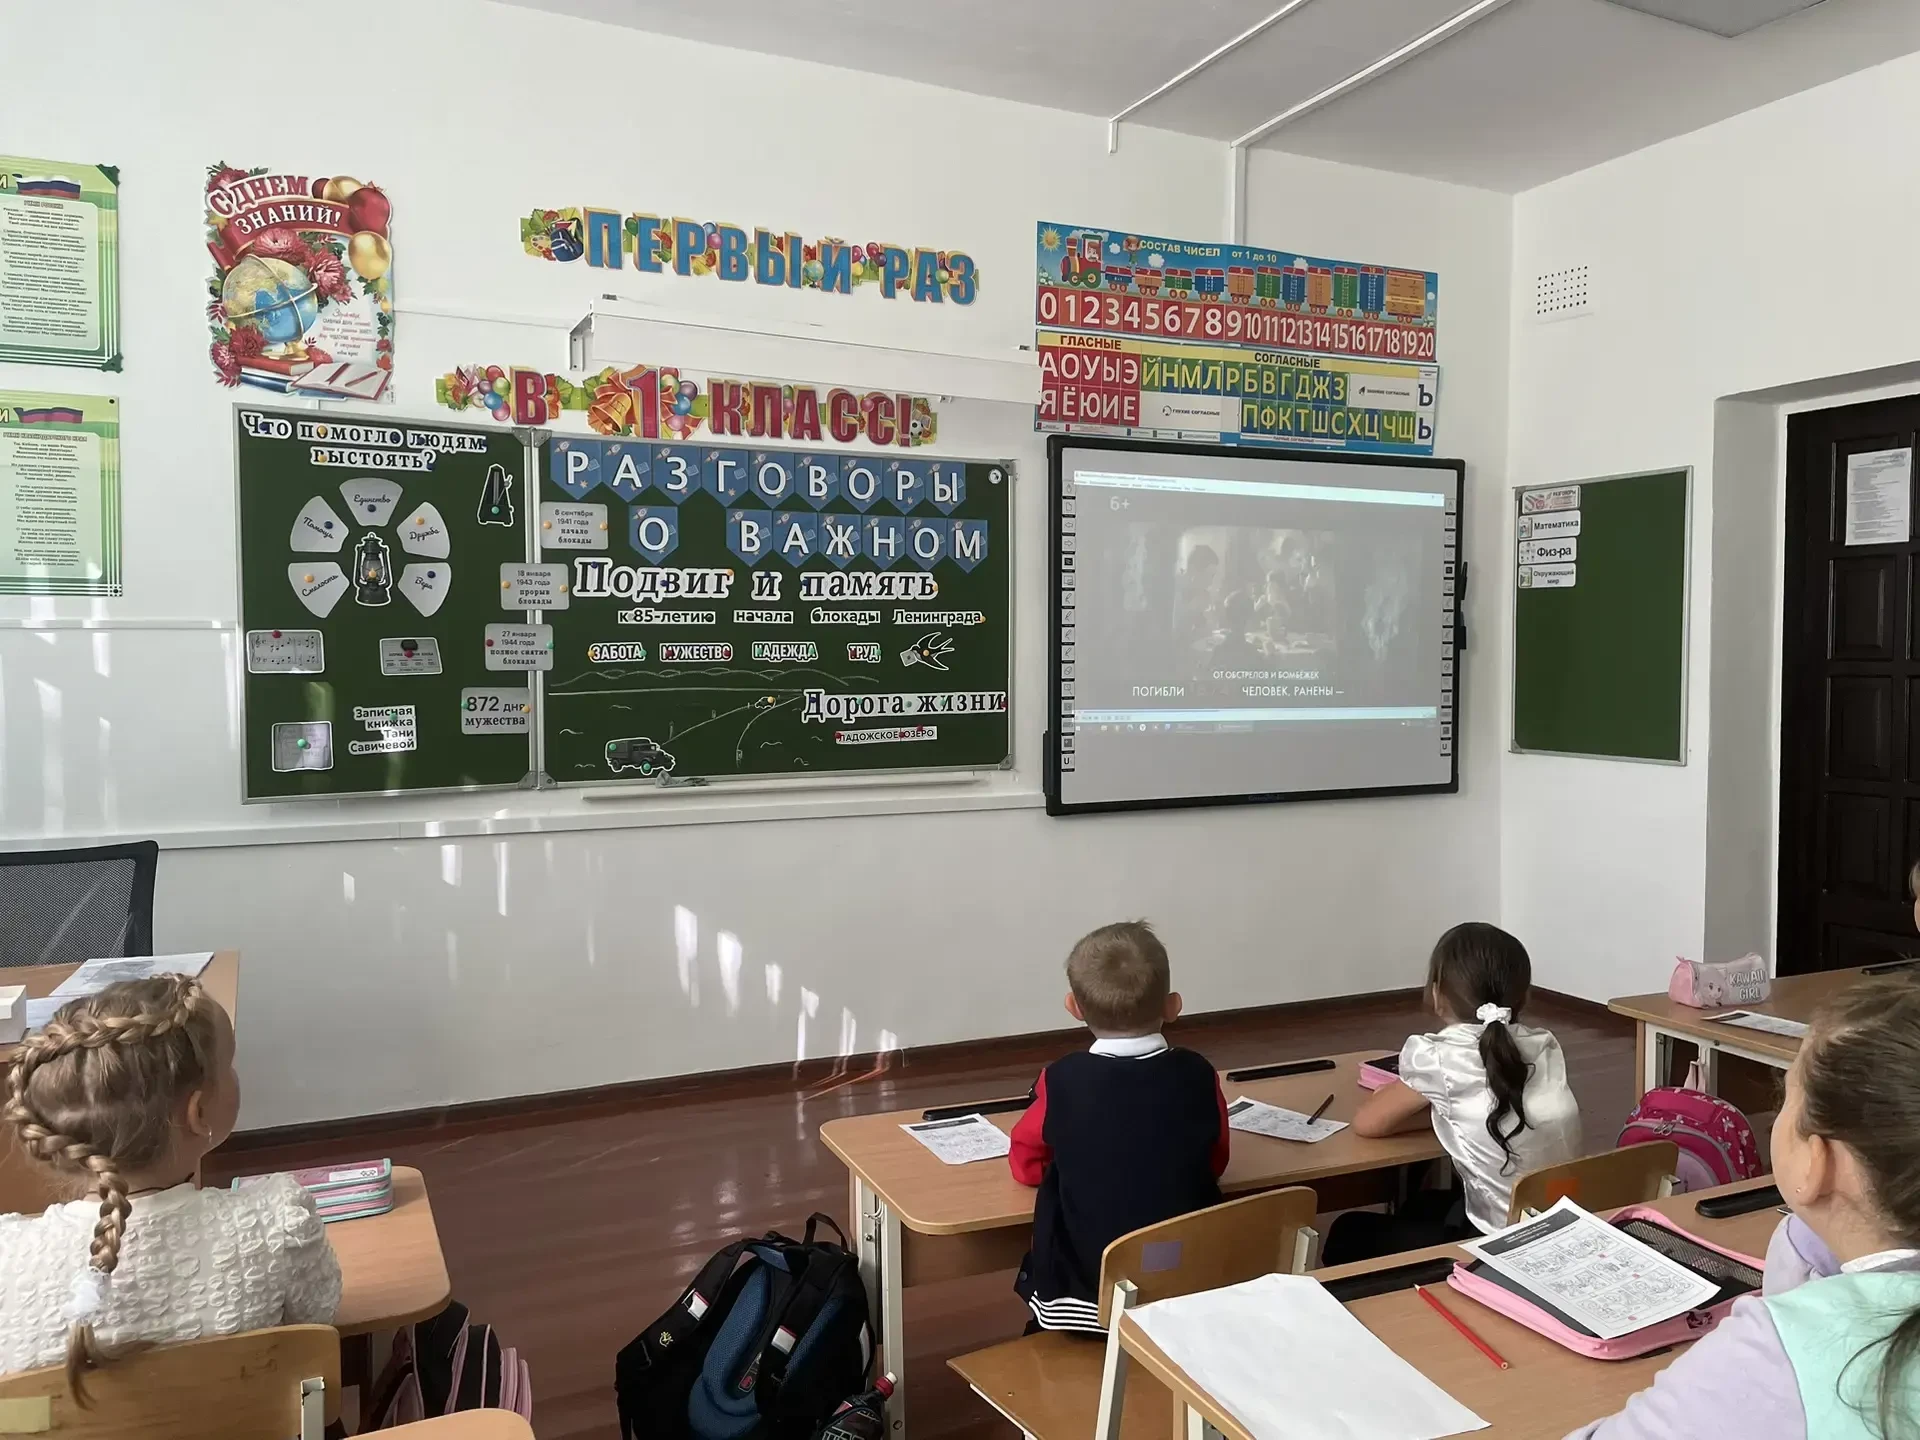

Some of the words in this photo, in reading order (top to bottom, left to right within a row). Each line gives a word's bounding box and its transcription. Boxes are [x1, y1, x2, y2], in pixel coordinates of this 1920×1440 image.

[229, 175, 308, 209] ДНЕМ
[234, 204, 342, 234] ЗНАНИЙ!
[1139, 239, 1181, 254] СОСТАВ
[1184, 246, 1221, 257] ЧИСЕЛ
[583, 207, 853, 294] ПЕРВЫЙ
[880, 243, 977, 305] РАЗ
[1245, 250, 1250, 259] 1
[1252, 253, 1264, 262] до
[1266, 254, 1277, 263] 10
[1040, 292, 1057, 320] 0
[1065, 295, 1076, 322] 1
[1083, 296, 1100, 324] 2
[1105, 298, 1120, 326] 3
[1124, 301, 1140, 329] 4
[1145, 303, 1160, 330] 5
[1164, 305, 1181, 332] 6
[1184, 307, 1201, 334] 7
[1205, 308, 1222, 336] 8
[1226, 310, 1242, 337] 9
[1244, 312, 1261, 339] 10
[1263, 315, 1278, 342] 11
[1280, 317, 1296, 344] 12
[1297, 319, 1313, 346] 13
[1314, 321, 1330, 347] 14
[1332, 323, 1349, 349] 15
[1350, 325, 1366, 351] 16
[1367, 326, 1384, 352] 17
[1384, 328, 1400, 354] 18
[1401, 330, 1417, 355] 19
[1418, 332, 1434, 357] 20
[1060, 335, 1122, 350] ГЛАСНЫЕ
[1254, 352, 1321, 369] СОГЛАСНЫЕ
[509, 366, 547, 425] В
[627, 367, 660, 439] 1
[707, 377, 912, 447] КЛАСС!
[244, 414, 289, 436] Что
[300, 424, 401, 444] помогло
[410, 433, 486, 451] людям
[566, 451, 958, 502] РАЗГОВОРЫ
[353, 494, 391, 506] Единство
[1110, 496, 1130, 511] 6+
[304, 517, 334, 539] Помощь
[1534, 519, 1579, 530] Математика
[409, 527, 439, 542] Дружба
[638, 517, 669, 552] О
[740, 520, 981, 560] ВАЖНОМ
[1537, 547, 1572, 558] Физ-ра
[577, 562, 732, 598] Подвиг
[754, 574, 777, 596] и
[803, 575, 935, 597] память
[1533, 569, 1575, 578] Окружающий
[302, 575, 338, 596] Смелость
[415, 577, 433, 590] Вера
[520, 589, 550, 597] прорыв
[518, 597, 552, 605] блокады
[633, 609, 714, 623] 85-летию
[736, 611, 792, 622] начала
[812, 608, 879, 625] блокады
[893, 610, 981, 626] Ленинграда
[593, 644, 641, 660] ЗАБОТА
[502, 657, 537, 665] блокады
[1213, 671, 1223, 679] ОТ
[1225, 671, 1269, 679] ОБСТРЕЛОВ
[1271, 671, 1277, 679] И
[1278, 671, 1319, 680] БОМБЕЖЕК
[1132, 686, 1185, 697] ПОГИБЛИ
[1295, 686, 1333, 696] РАНЕНЫ
[466, 696, 500, 712] 872
[503, 702, 526, 713] дня
[803, 691, 905, 721] Дорога
[917, 693, 1005, 713] жизни
[356, 707, 413, 718] Записная
[367, 719, 413, 729] книжка
[465, 715, 526, 728] мужества
[384, 729, 414, 739] Тани
[839, 731, 898, 742] ЛАДОЖСКОЕ
[903, 729, 934, 738] ОЗЕРО
[351, 739, 415, 753] Савичевой
[1730, 970, 1766, 985] KAWAII
[1740, 988, 1761, 1000] GIRL
